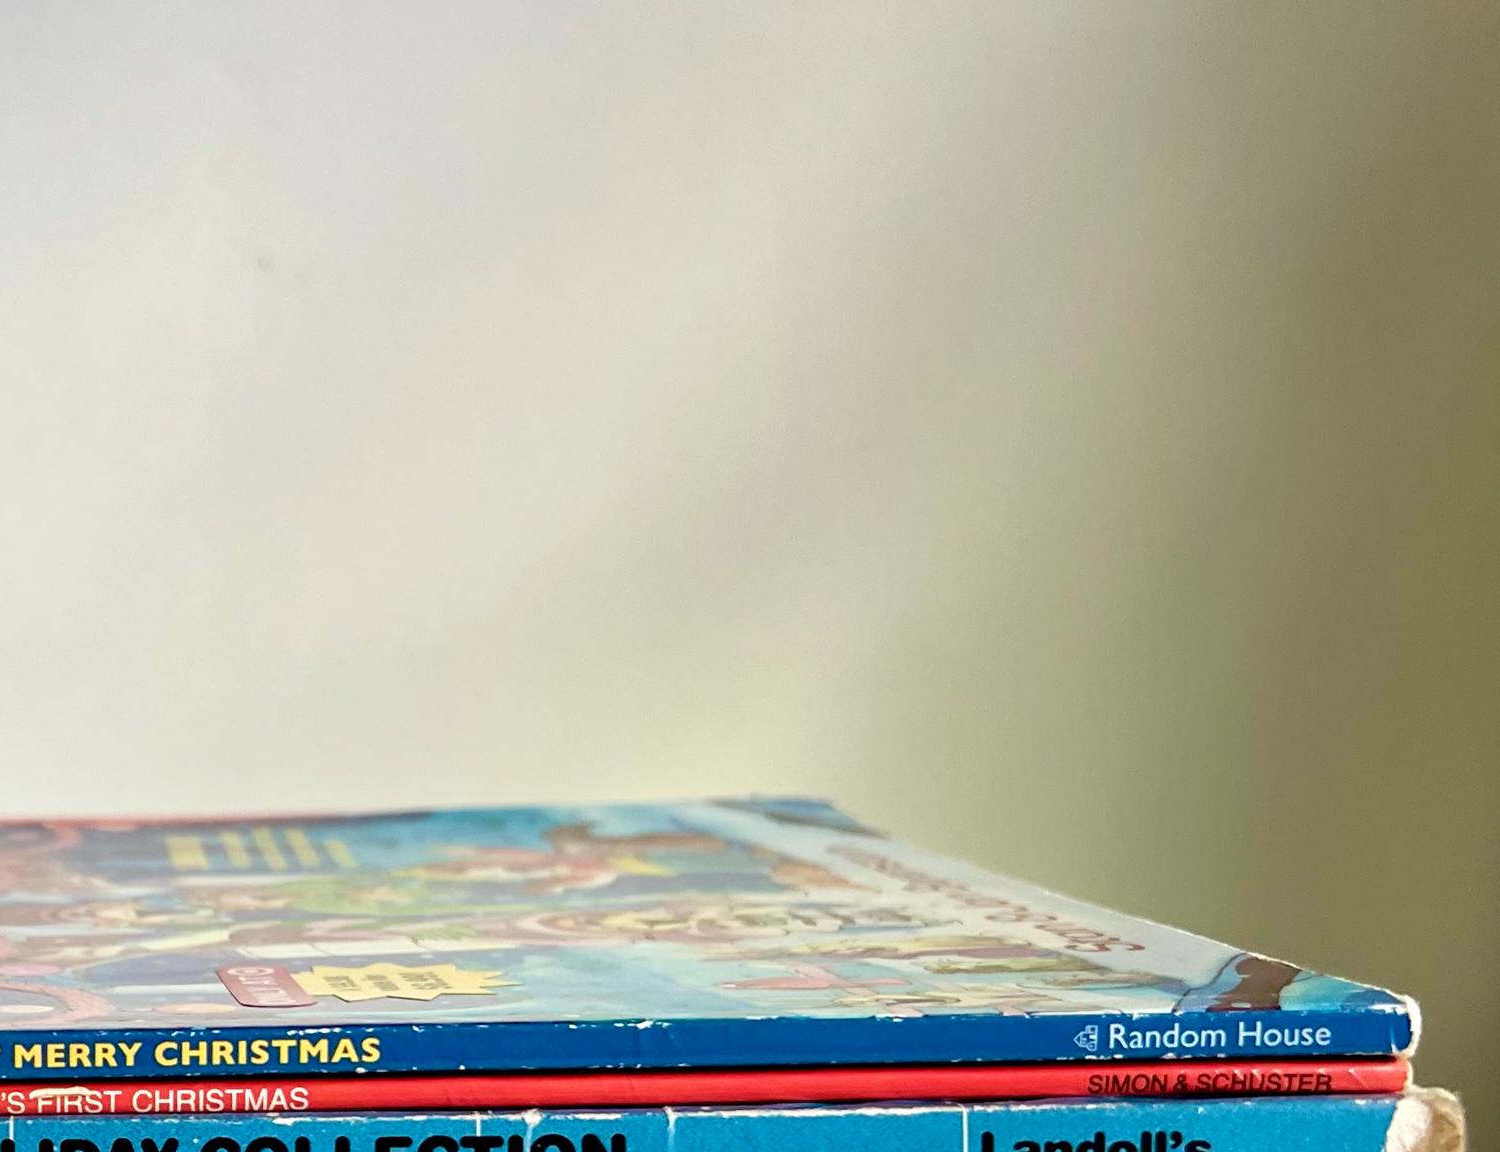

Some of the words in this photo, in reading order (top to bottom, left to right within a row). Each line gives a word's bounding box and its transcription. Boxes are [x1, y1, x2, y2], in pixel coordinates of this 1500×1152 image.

[1108, 1022, 1227, 1049] Random
[1237, 1021, 1332, 1046] House
[13, 1041, 144, 1070] MERRY
[154, 1037, 382, 1067] CHRISTMAS
[1087, 1073, 1168, 1095] SIMON
[1170, 1073, 1188, 1094] &
[1194, 1072, 1333, 1094] SCHUSTER
[36, 1091, 122, 1115] FIRST
[131, 1087, 309, 1113] CHRISTMAS
